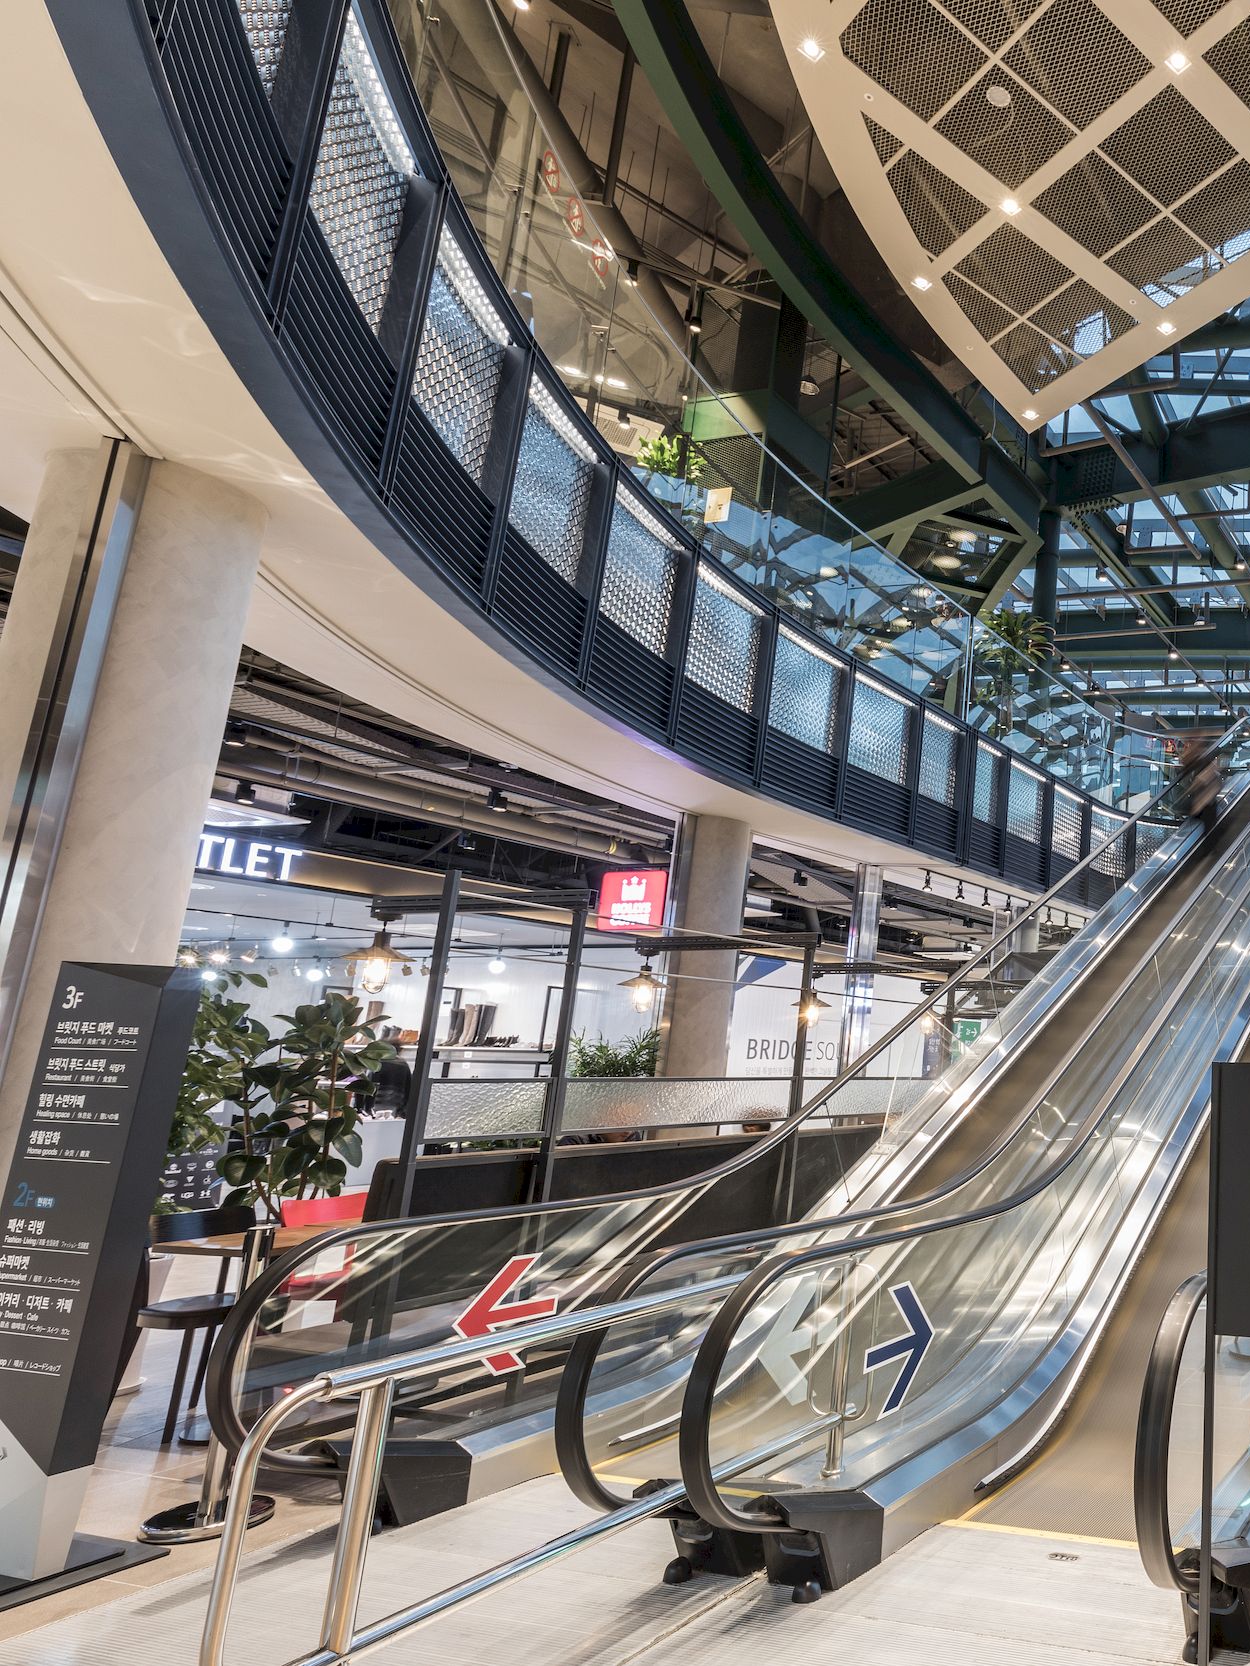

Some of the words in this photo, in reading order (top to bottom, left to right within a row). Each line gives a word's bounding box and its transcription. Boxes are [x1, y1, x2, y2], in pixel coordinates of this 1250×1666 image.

[199, 833, 303, 881] TLET
[62, 985, 85, 1009] 3F
[55, 1021, 80, 1035] 브릿지
[80, 1021, 97, 1035] 푸드
[97, 1021, 115, 1035] 마켓
[54, 1036, 68, 1045] Food
[68, 1037, 82, 1045] Court
[816, 1041, 841, 1061] SQ
[46, 1057, 69, 1071] 브릿지
[69, 1058, 84, 1071] 푸드
[83, 1058, 107, 1072] 스트릿
[45, 1073, 72, 1082] Restaurant
[38, 1092, 54, 1108] 힐링
[54, 1094, 86, 1109] 수면카페
[36, 1110, 55, 1119] Healing
[55, 1111, 71, 1120] space
[29, 1130, 61, 1145] 생활잡화
[27, 1147, 41, 1155] Home
[41, 1148, 58, 1157] goods
[13, 1182, 36, 1208] 2F
[0, 1272, 28, 1281] upermarket
[26, 1295, 50, 1310] 디저트
[56, 1298, 74, 1314] 카페
[4, 1310, 23, 1320] Dessert
[26, 1312, 39, 1321] Cafe
